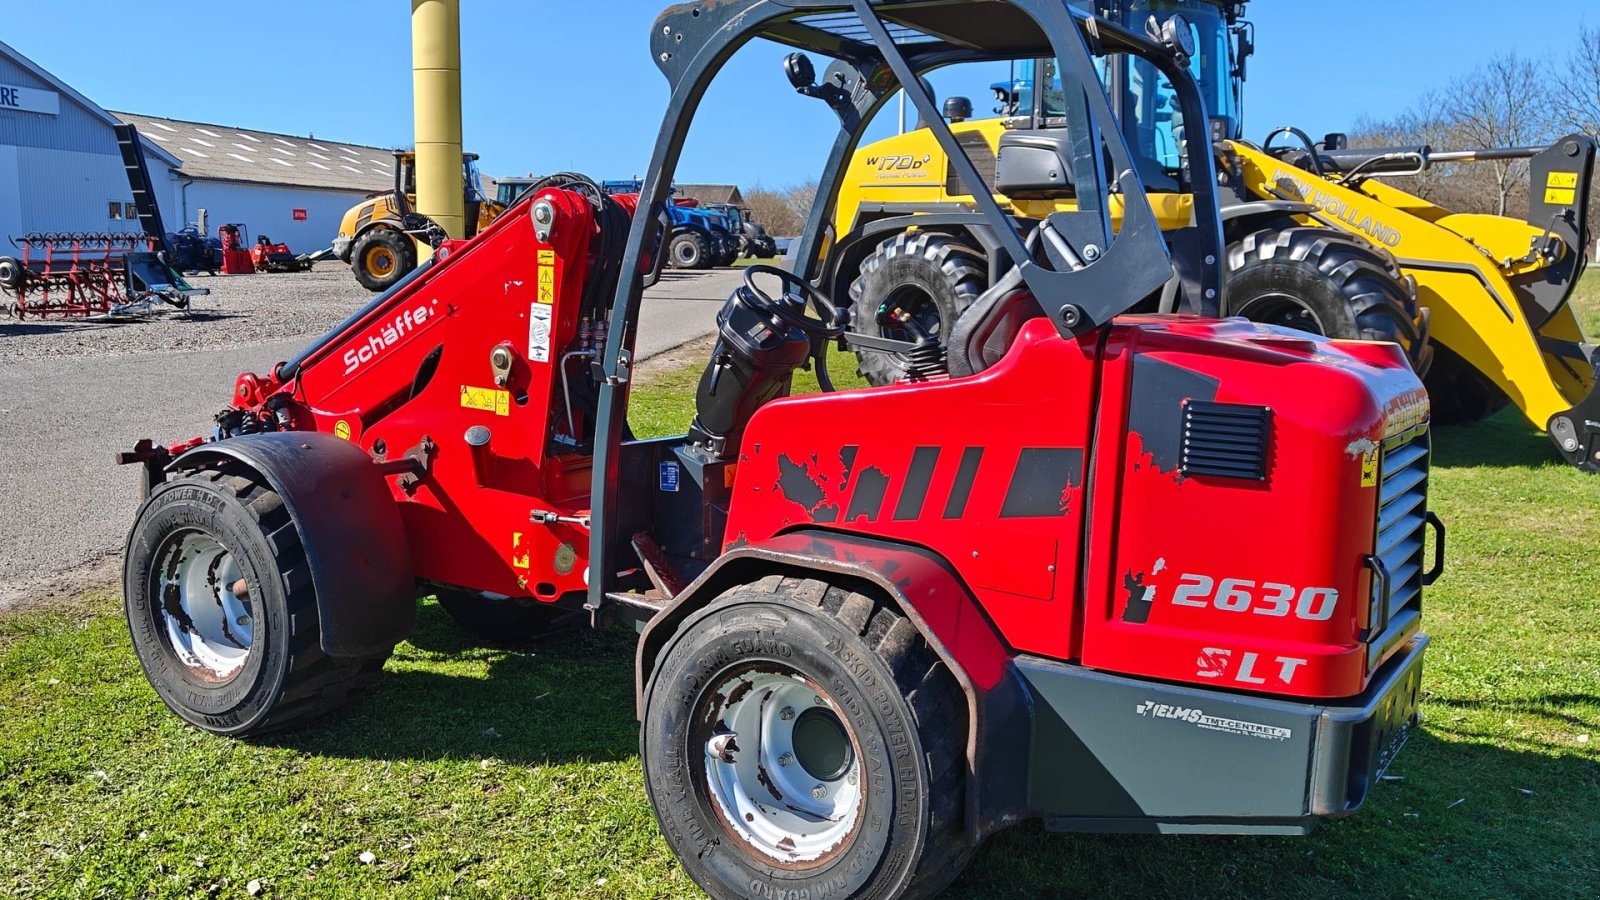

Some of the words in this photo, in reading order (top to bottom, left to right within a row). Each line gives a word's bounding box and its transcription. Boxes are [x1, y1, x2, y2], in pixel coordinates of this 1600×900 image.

[0, 86, 20, 107] RE
[1311, 189, 1402, 247] HOLLAND
[163, 488, 194, 505] POWER
[1171, 573, 1340, 621] 2630
[731, 637, 793, 659] GUARD
[833, 677, 868, 728] WIDE
[842, 649, 876, 687] SKID
[873, 689, 911, 760] POWER
